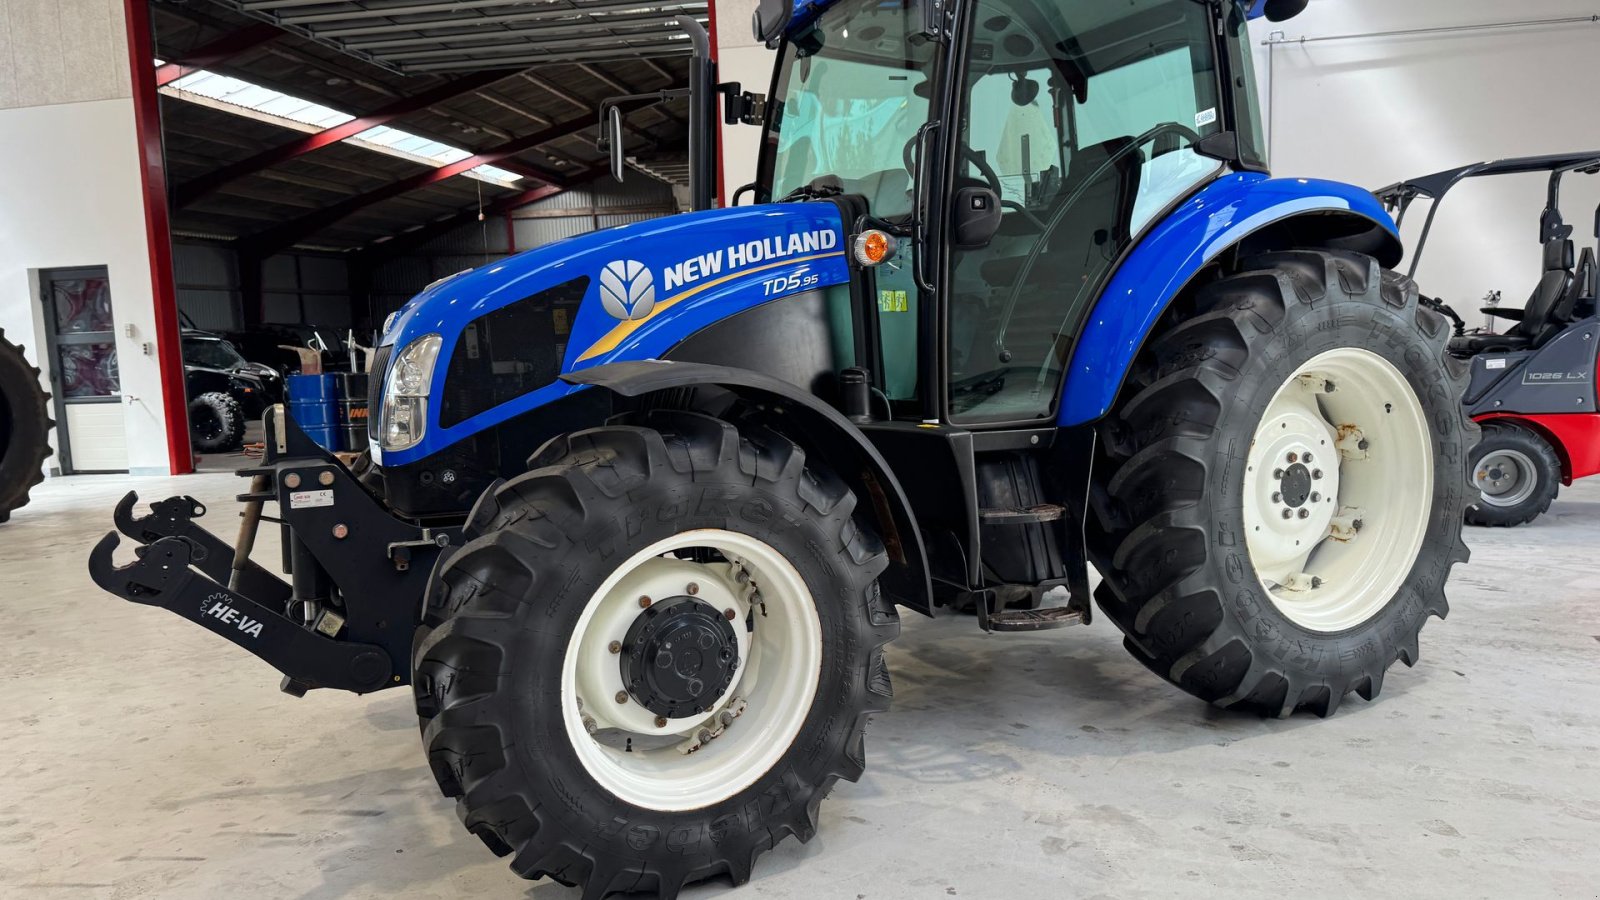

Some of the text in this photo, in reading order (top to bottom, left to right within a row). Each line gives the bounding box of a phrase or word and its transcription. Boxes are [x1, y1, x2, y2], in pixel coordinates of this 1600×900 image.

[663, 229, 836, 291] NEW HOLLAND
[1528, 372, 1563, 380] 1026
[207, 602, 263, 638] HE-VA
